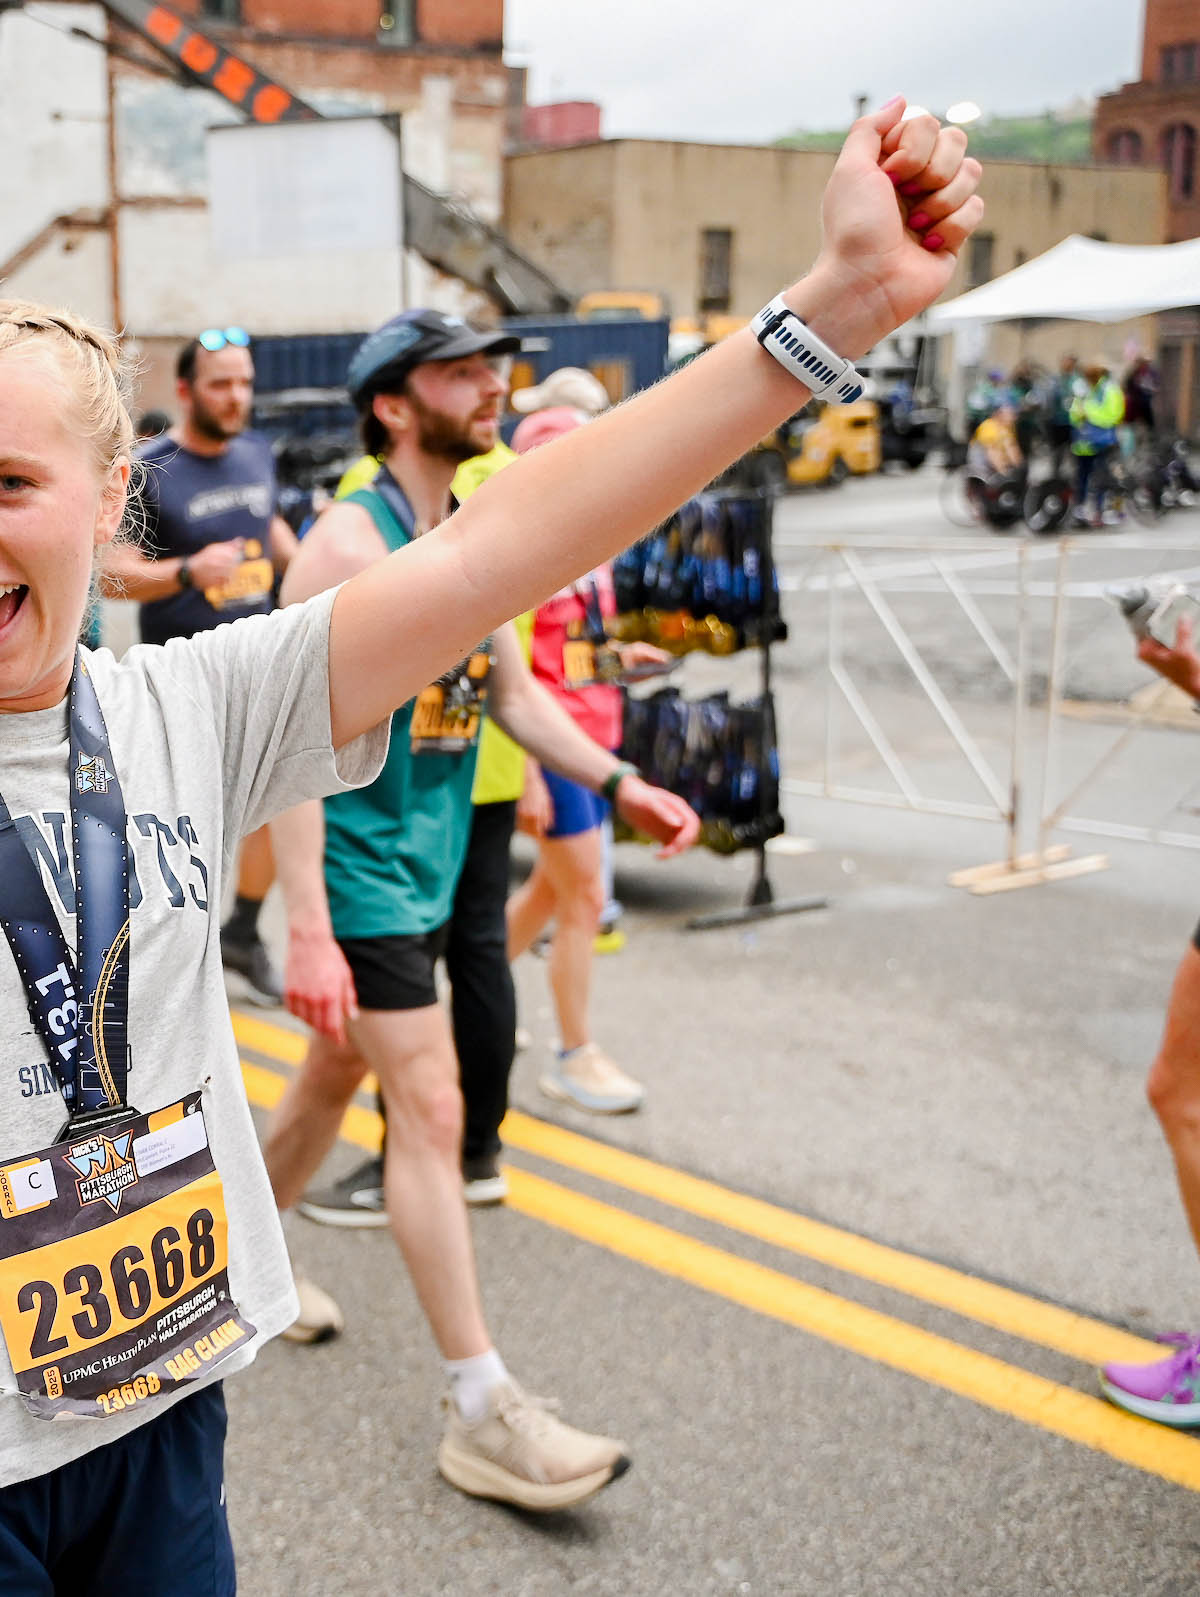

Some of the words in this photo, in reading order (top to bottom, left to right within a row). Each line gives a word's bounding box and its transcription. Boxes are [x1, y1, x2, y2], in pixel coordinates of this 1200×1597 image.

[18, 1063, 60, 1098] SIN
[71, 1139, 99, 1159] DICK'S
[28, 1171, 42, 1189] C
[79, 1164, 133, 1192] PITTSBURGH
[82, 1173, 135, 1201] MARATHON
[17, 1208, 215, 1359] 23668
[156, 1284, 215, 1331] PITTSBURGH
[159, 1323, 179, 1344] HALF
[177, 1299, 218, 1334] MARATHON
[164, 1347, 202, 1382] BAG
[193, 1318, 246, 1365] CLAIM
[46, 1368, 59, 1396] 2025
[63, 1361, 102, 1384] UPMC
[95, 1371, 161, 1414] 23668
